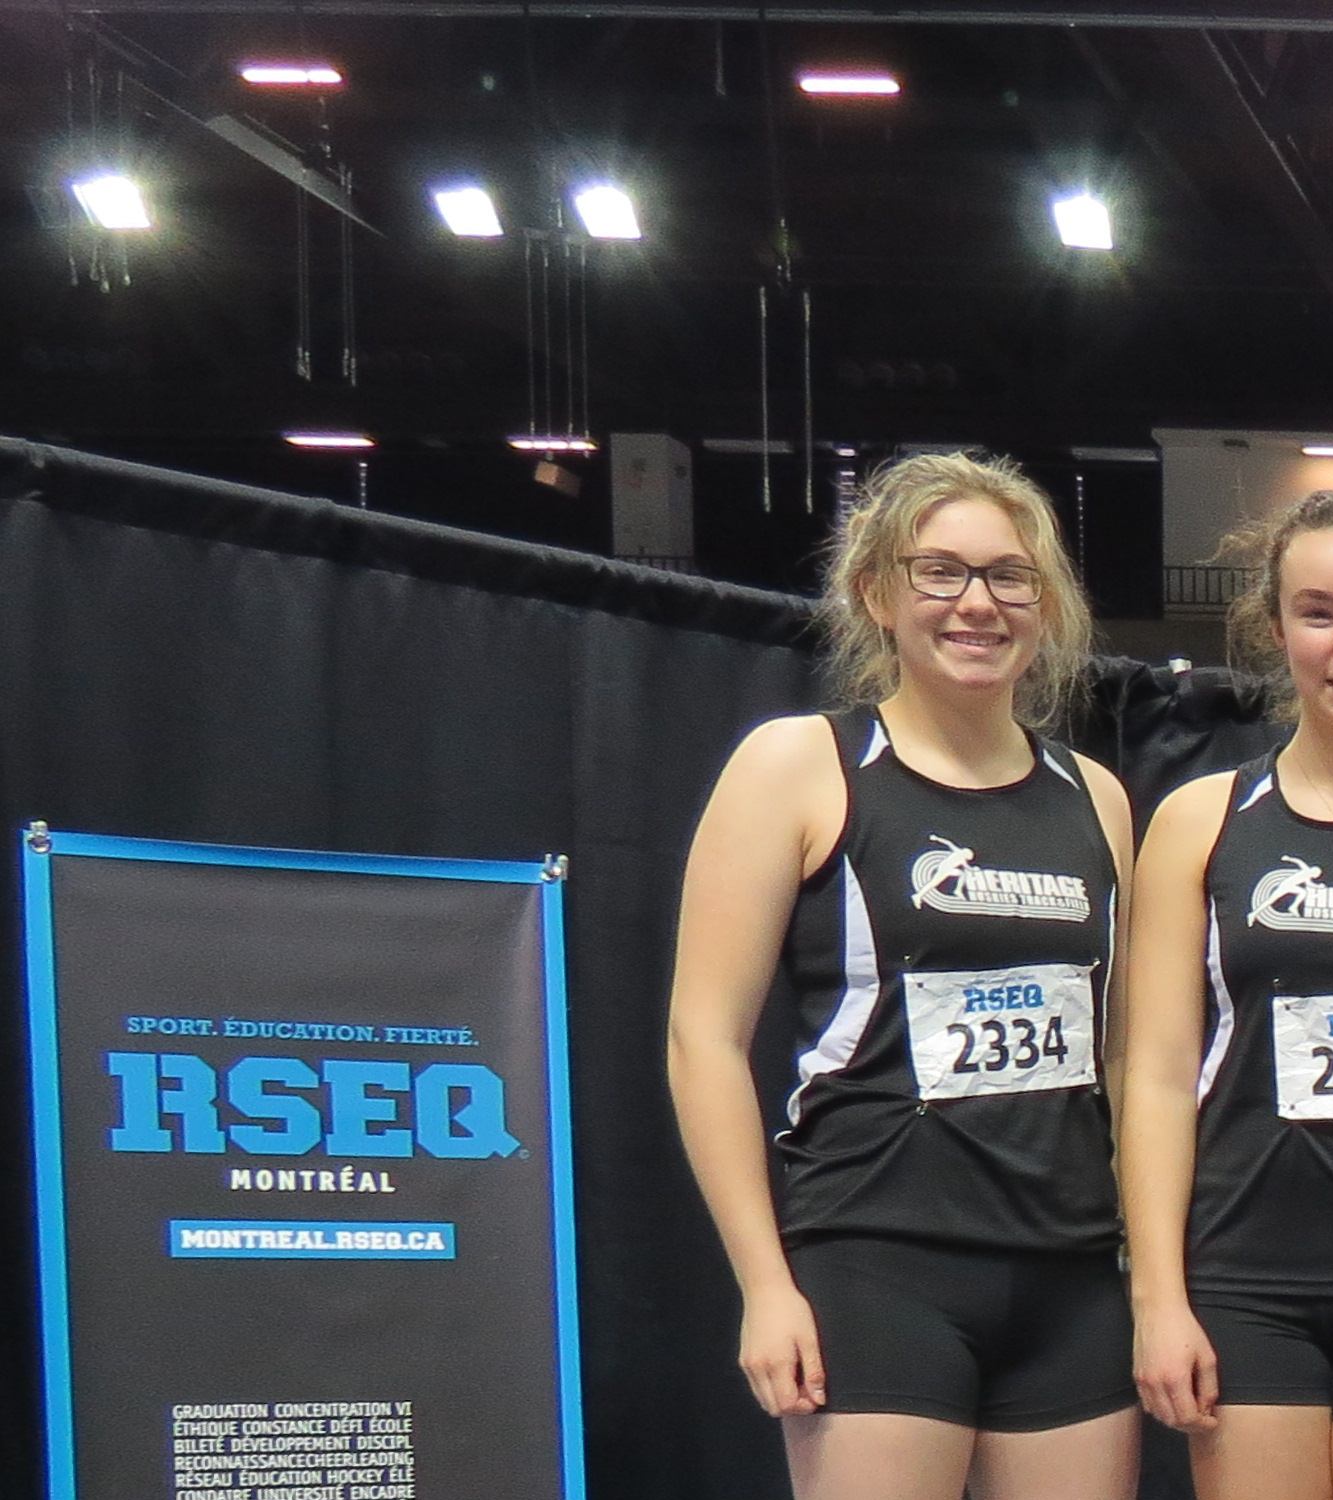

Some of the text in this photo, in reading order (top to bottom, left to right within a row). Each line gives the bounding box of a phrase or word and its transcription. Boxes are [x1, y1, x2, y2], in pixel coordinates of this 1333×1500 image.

[966, 867, 1088, 901] HERITAGE
[964, 984, 1044, 1012] RSEQ
[127, 1016, 479, 1046] SPORT. ÉDUCATION. FIERTÉ.
[946, 1016, 1068, 1074] 2334
[107, 1051, 521, 1159] RSEQ
[231, 1165, 395, 1193] MONTRÉAL
[180, 1227, 444, 1251] MONTREAL.RSEQ.CA
[172, 1400, 411, 1420] GRADUATION CONCENTRATION VI
[173, 1415, 411, 1437] ÉTHIQUE CONSTANCE DÉFI ÉCOLE
[173, 1433, 411, 1454] BILETÉ DÉVELOPPEMENT DISCIPL
[350, 1483, 414, 1500] ENCADRE
